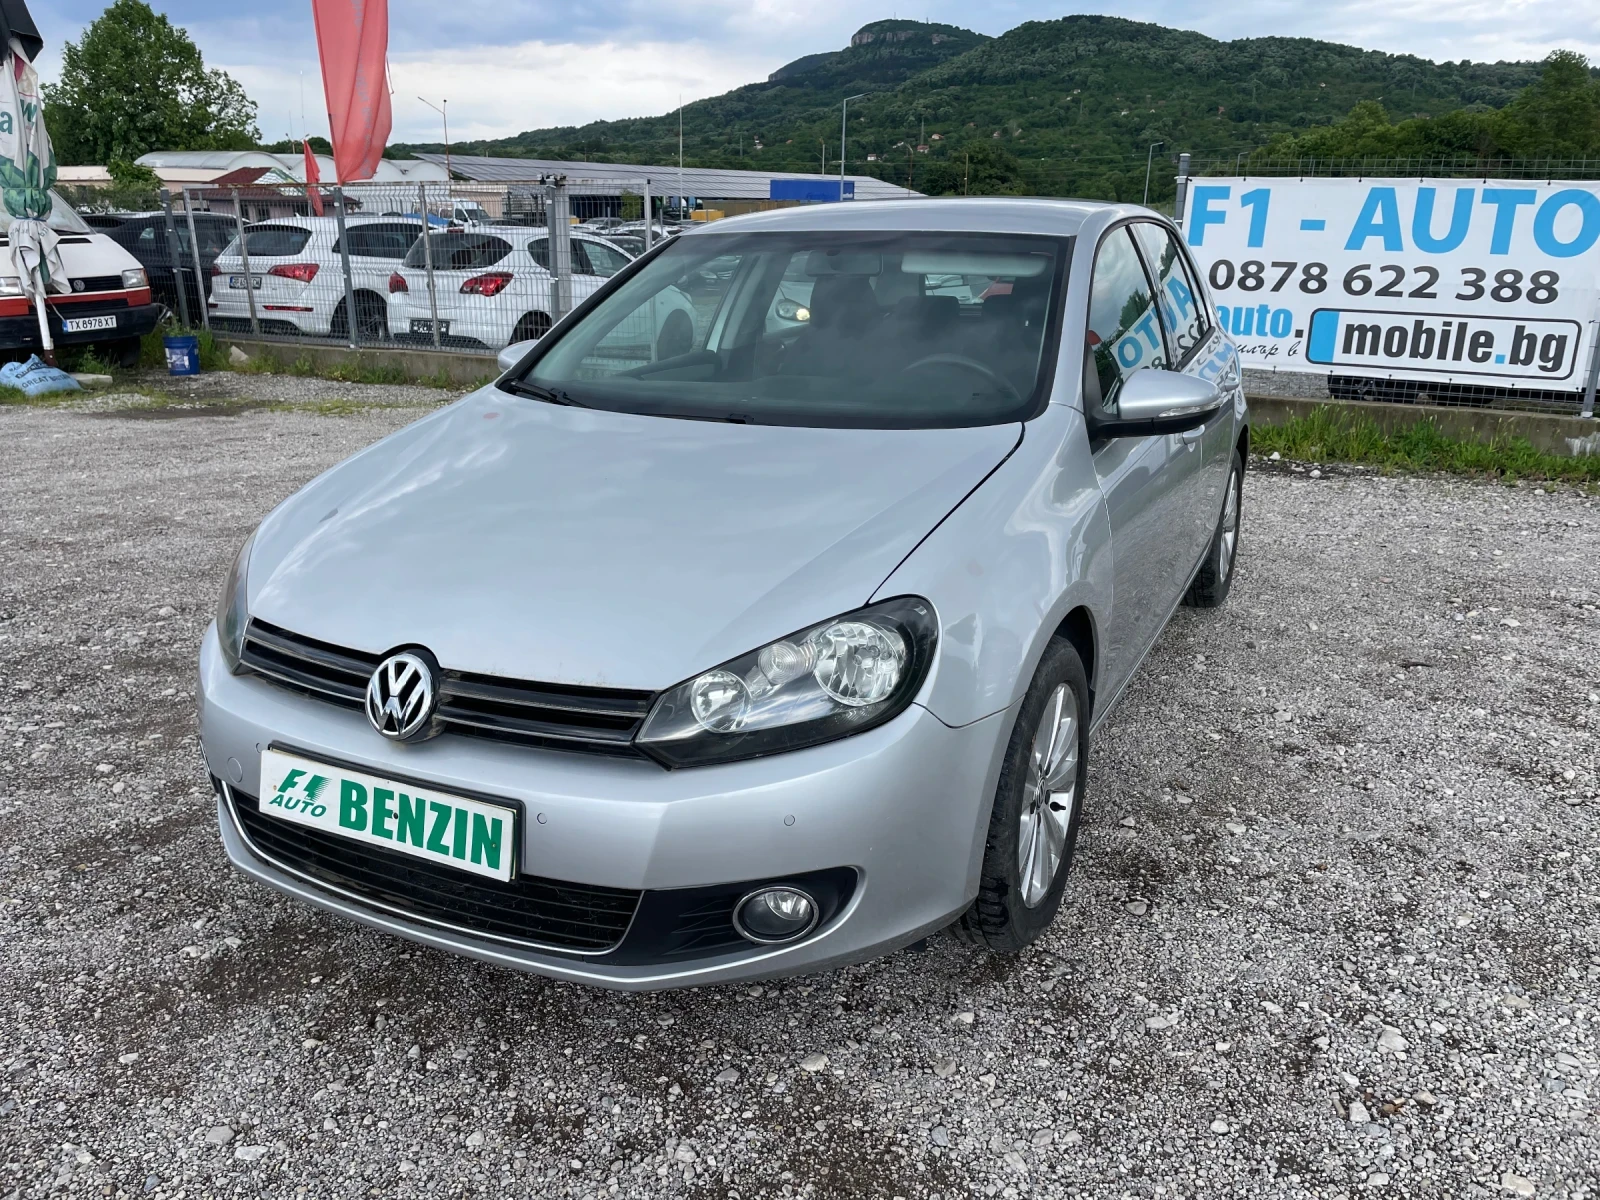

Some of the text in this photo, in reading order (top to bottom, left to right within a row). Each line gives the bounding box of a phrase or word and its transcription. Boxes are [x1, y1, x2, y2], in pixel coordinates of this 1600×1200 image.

[1188, 186, 1271, 248] F1
[1343, 187, 1600, 258] AUTO
[1209, 259, 1560, 304] 0878 622 388
[1342, 320, 1568, 372] mobile.bg
[21, 375, 49, 389] GREAT
[269, 793, 327, 817] AUTO
[277, 768, 333, 803] F1
[339, 778, 502, 871] BENZIN
